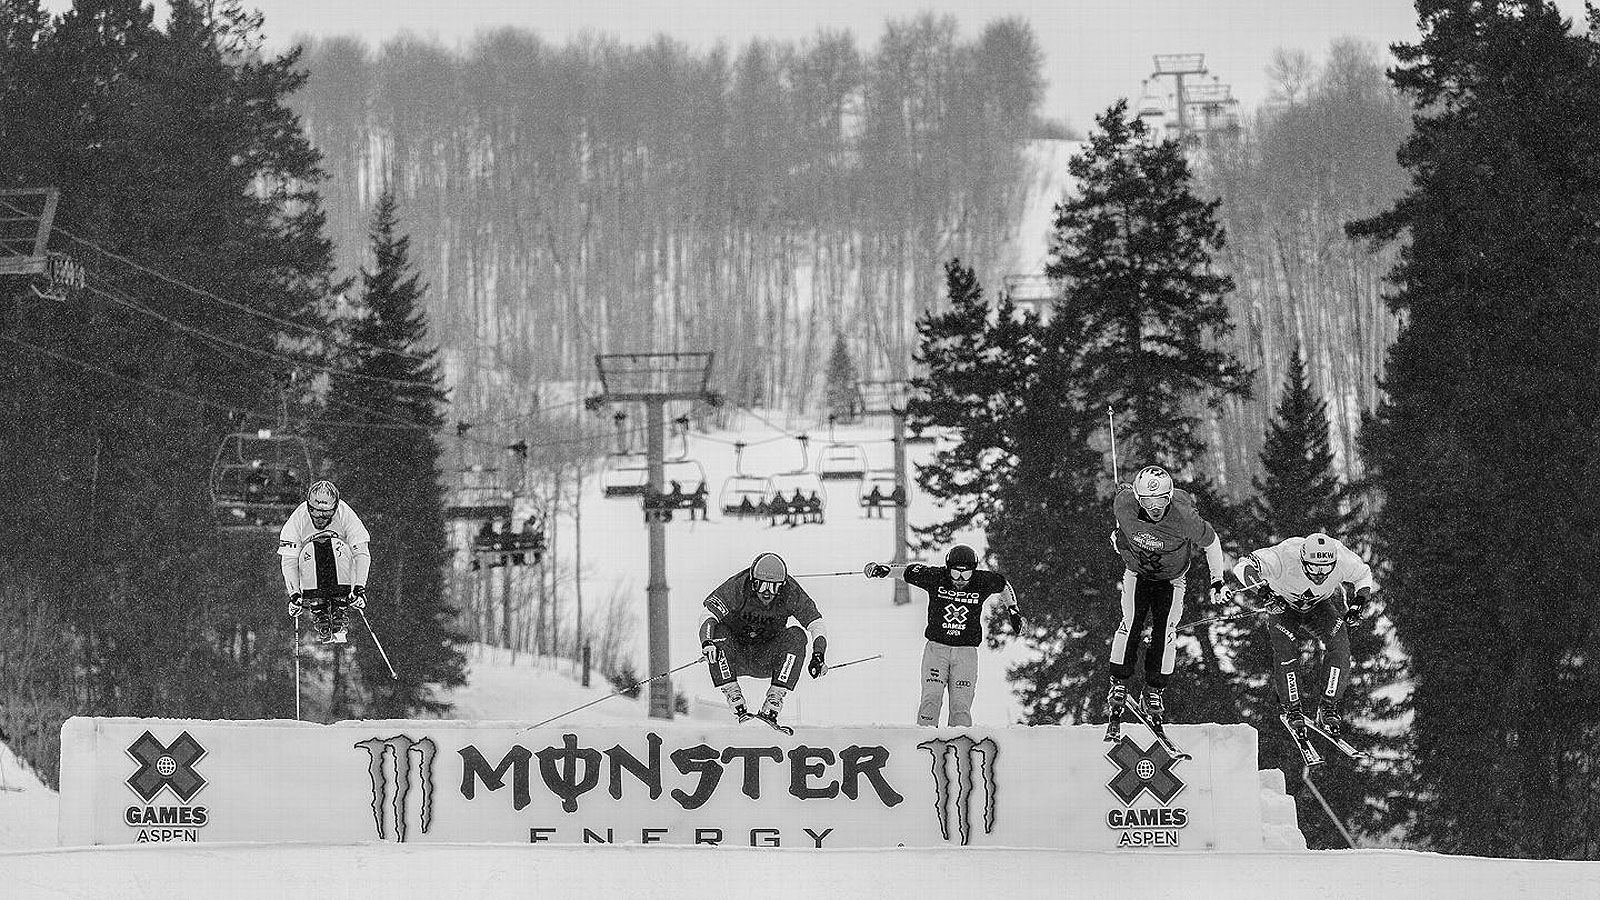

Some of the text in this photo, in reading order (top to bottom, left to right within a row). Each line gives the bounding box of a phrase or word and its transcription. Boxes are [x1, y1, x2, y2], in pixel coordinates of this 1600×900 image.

[1316, 551, 1334, 559] BKW
[125, 806, 208, 824] GAMES
[1107, 808, 1187, 827] GAMES
[137, 829, 197, 843] ASPEN
[1119, 831, 1177, 845] ASPEN
